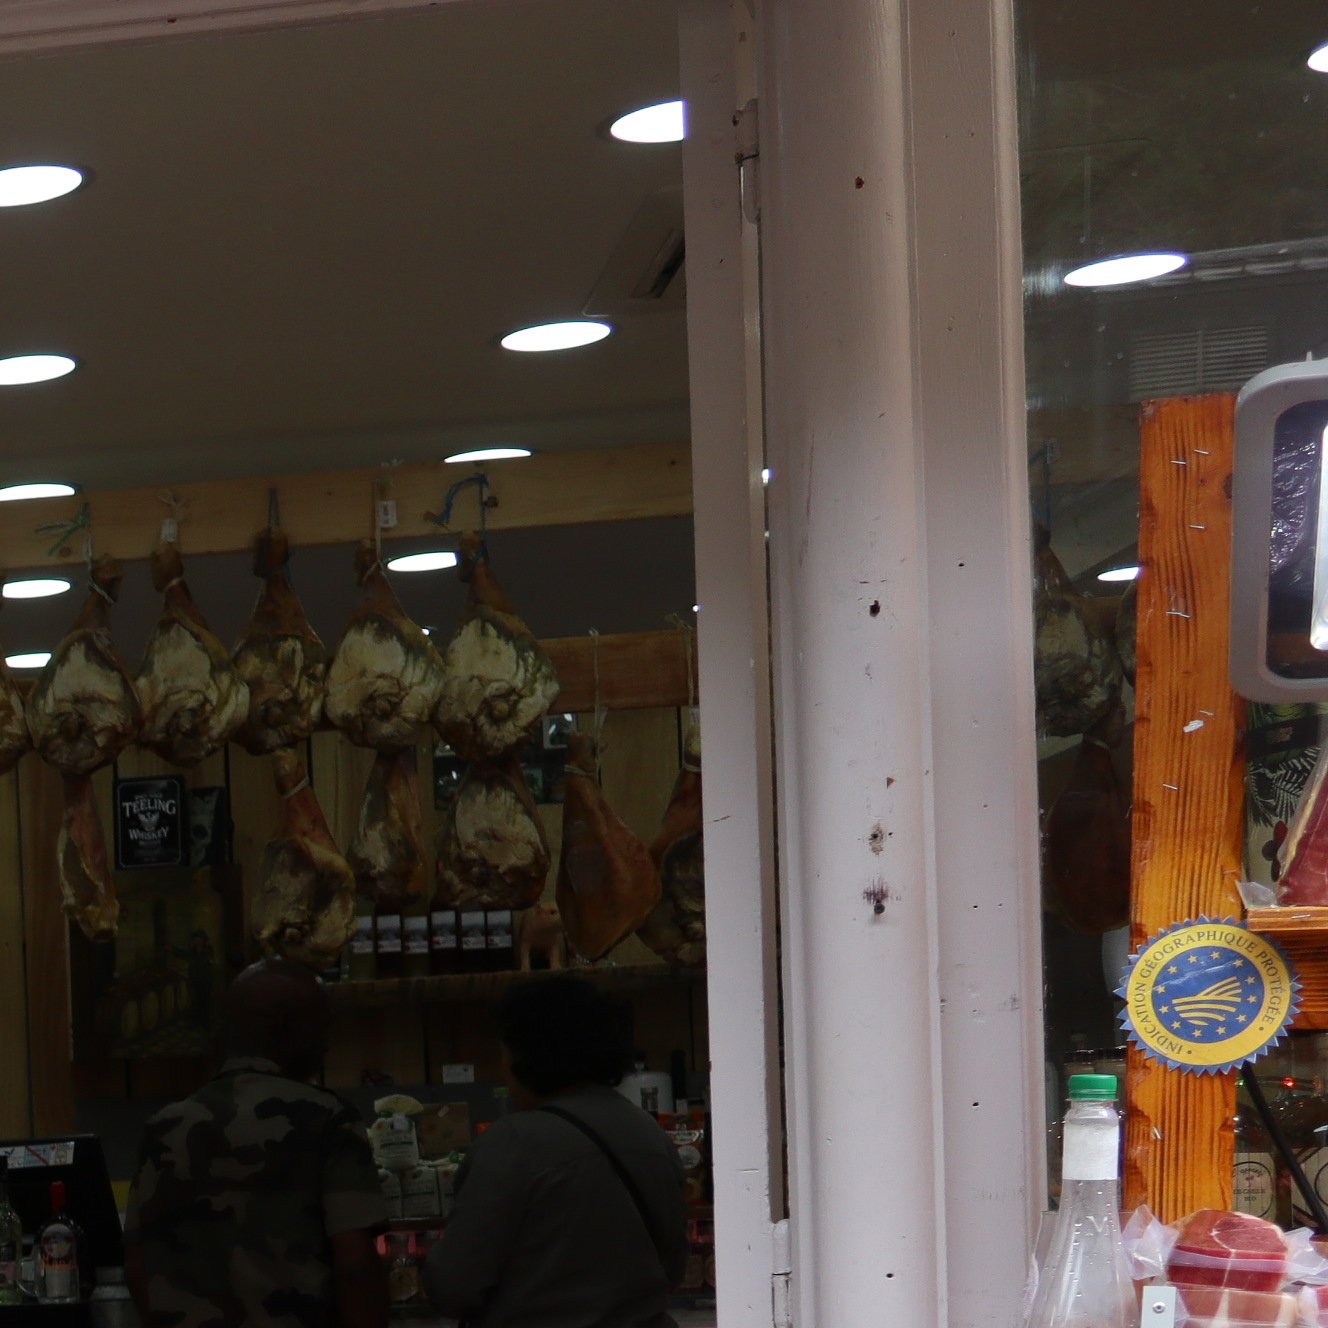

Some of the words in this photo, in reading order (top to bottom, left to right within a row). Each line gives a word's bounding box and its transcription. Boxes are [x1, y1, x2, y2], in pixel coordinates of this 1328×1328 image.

[122, 798, 177, 818] TEELING
[1140, 930, 1259, 978] GÉOGRAPHIQUE
[1256, 950, 1282, 1025] PROTÉGÉE
[1135, 982, 1184, 1055] INDICATION
